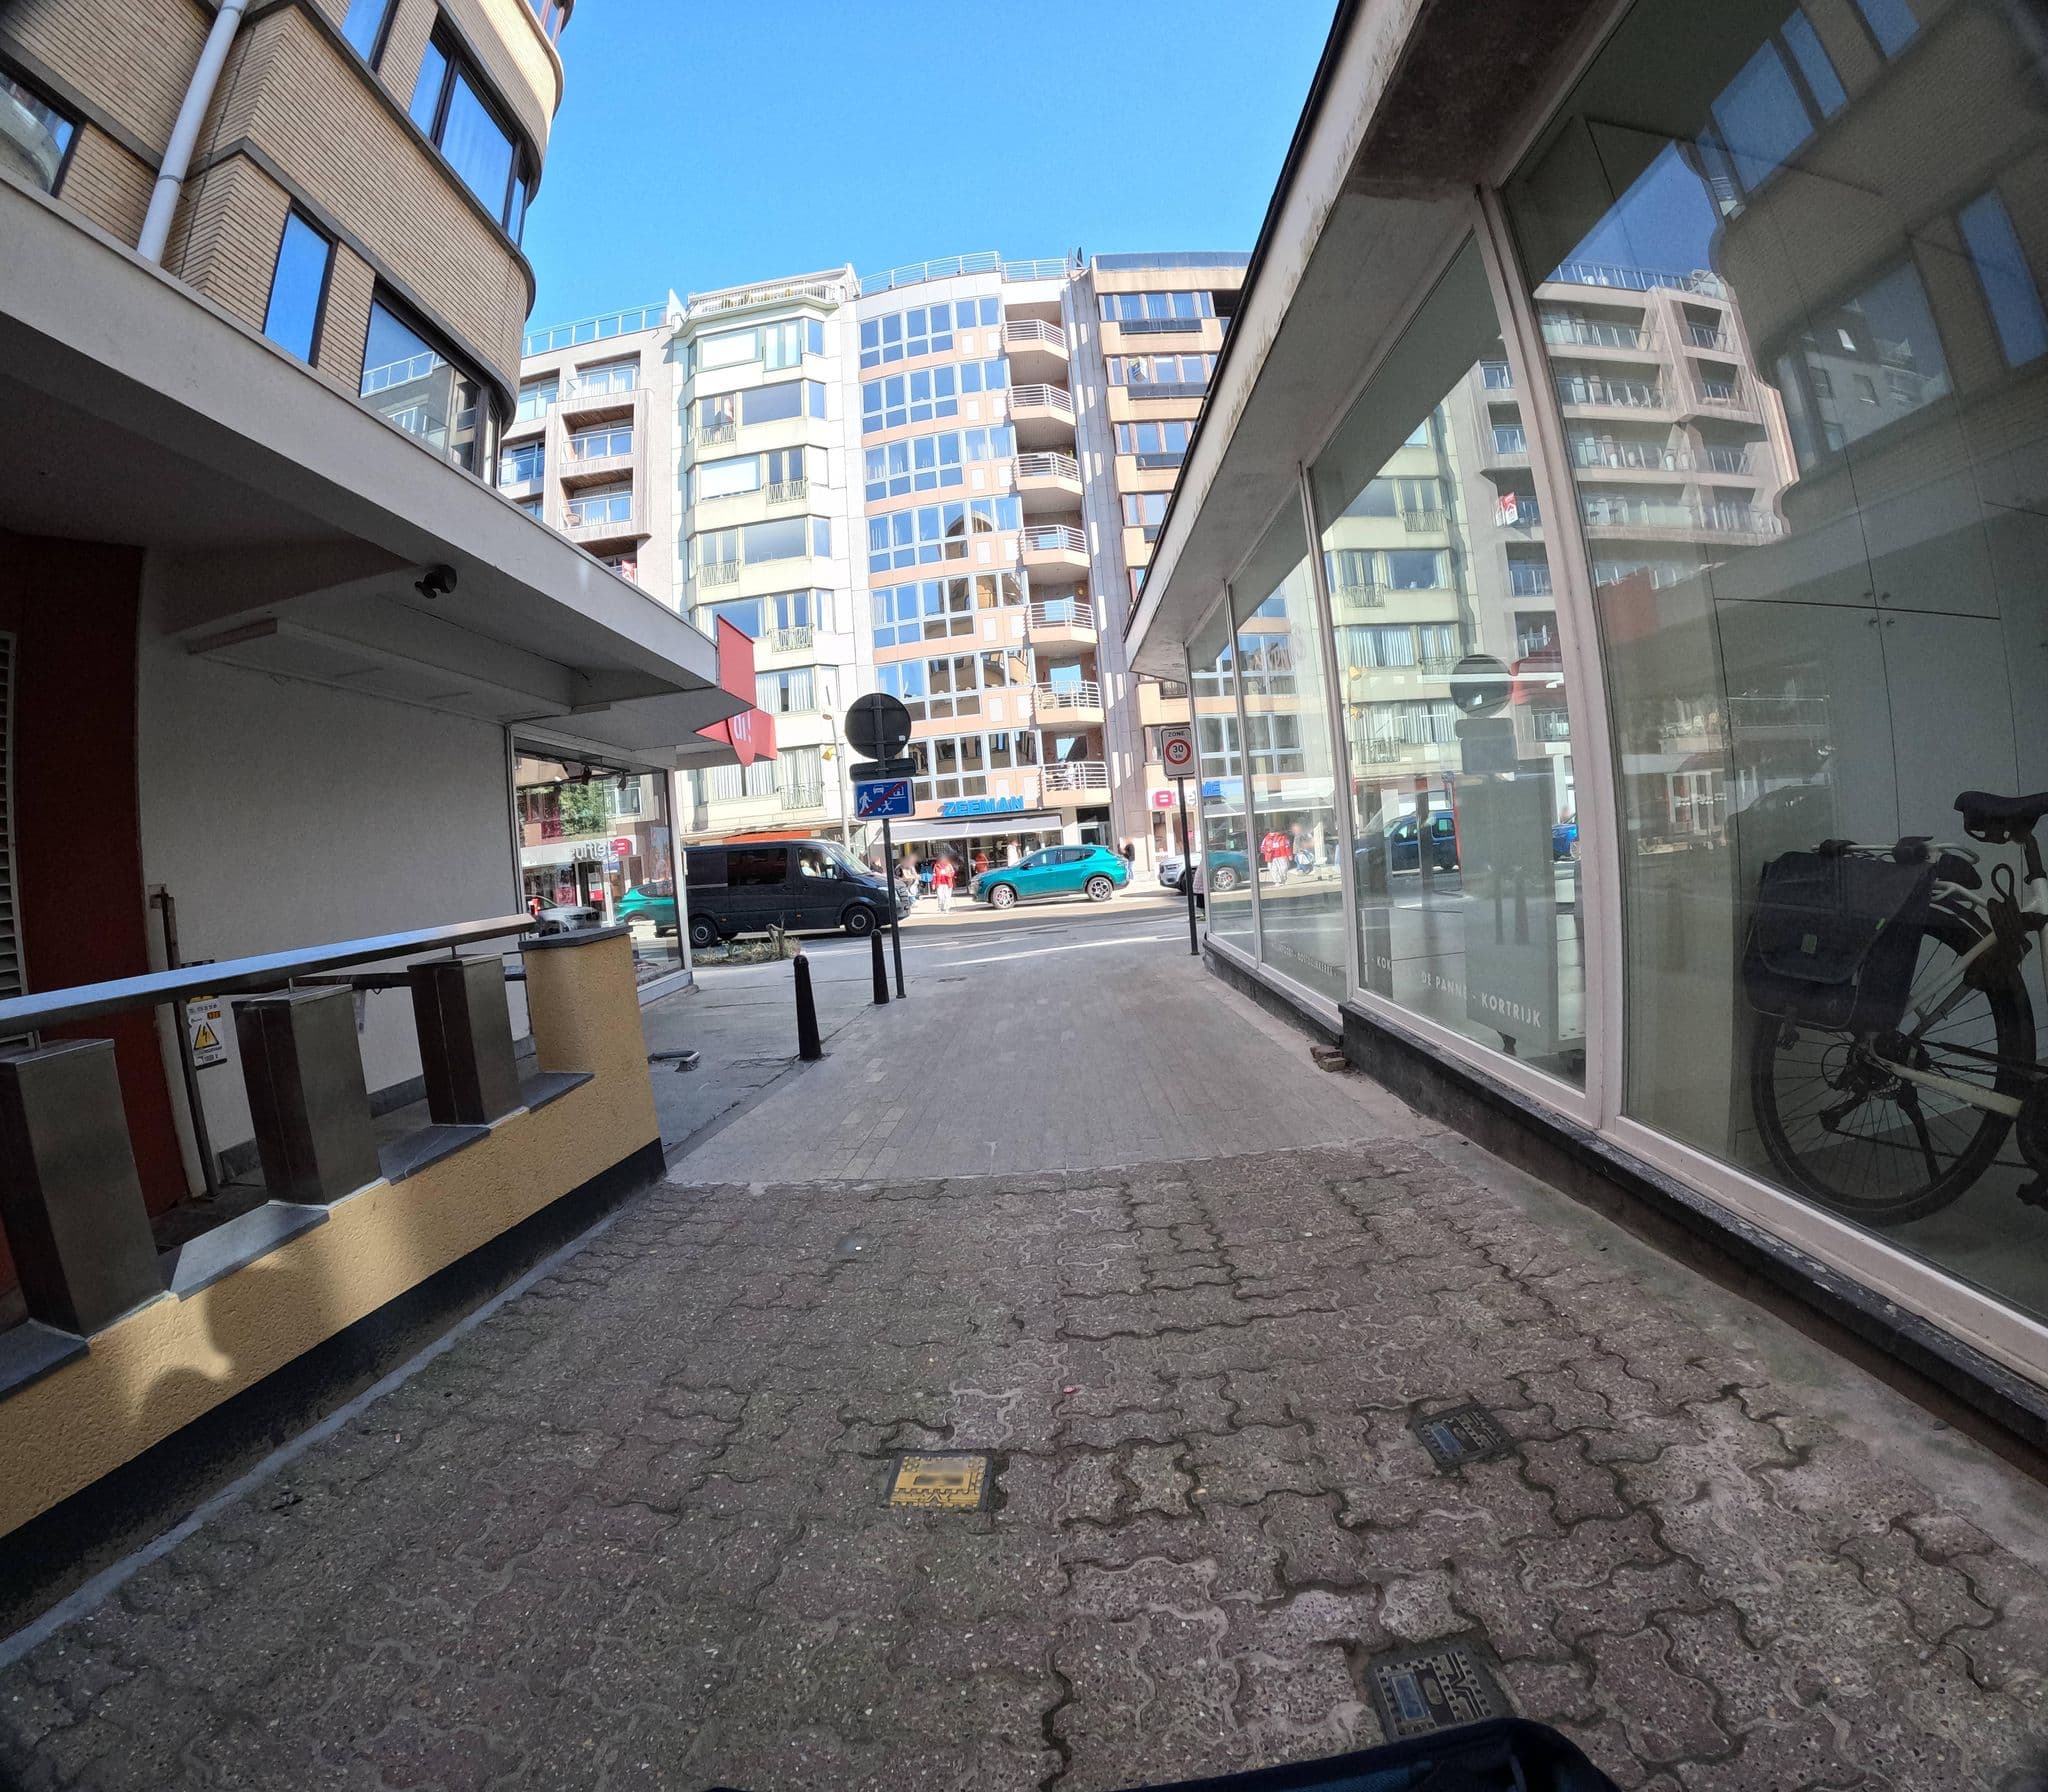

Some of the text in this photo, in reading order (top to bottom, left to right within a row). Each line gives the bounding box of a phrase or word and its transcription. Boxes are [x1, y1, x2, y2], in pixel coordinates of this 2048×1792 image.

[1172, 744, 1184, 753] 30
[943, 795, 1024, 818] ZEEMAN
[1421, 971, 1432, 987] DE
[1435, 975, 1467, 1000] PANNE
[1481, 992, 1542, 1028] KORTRIJK
